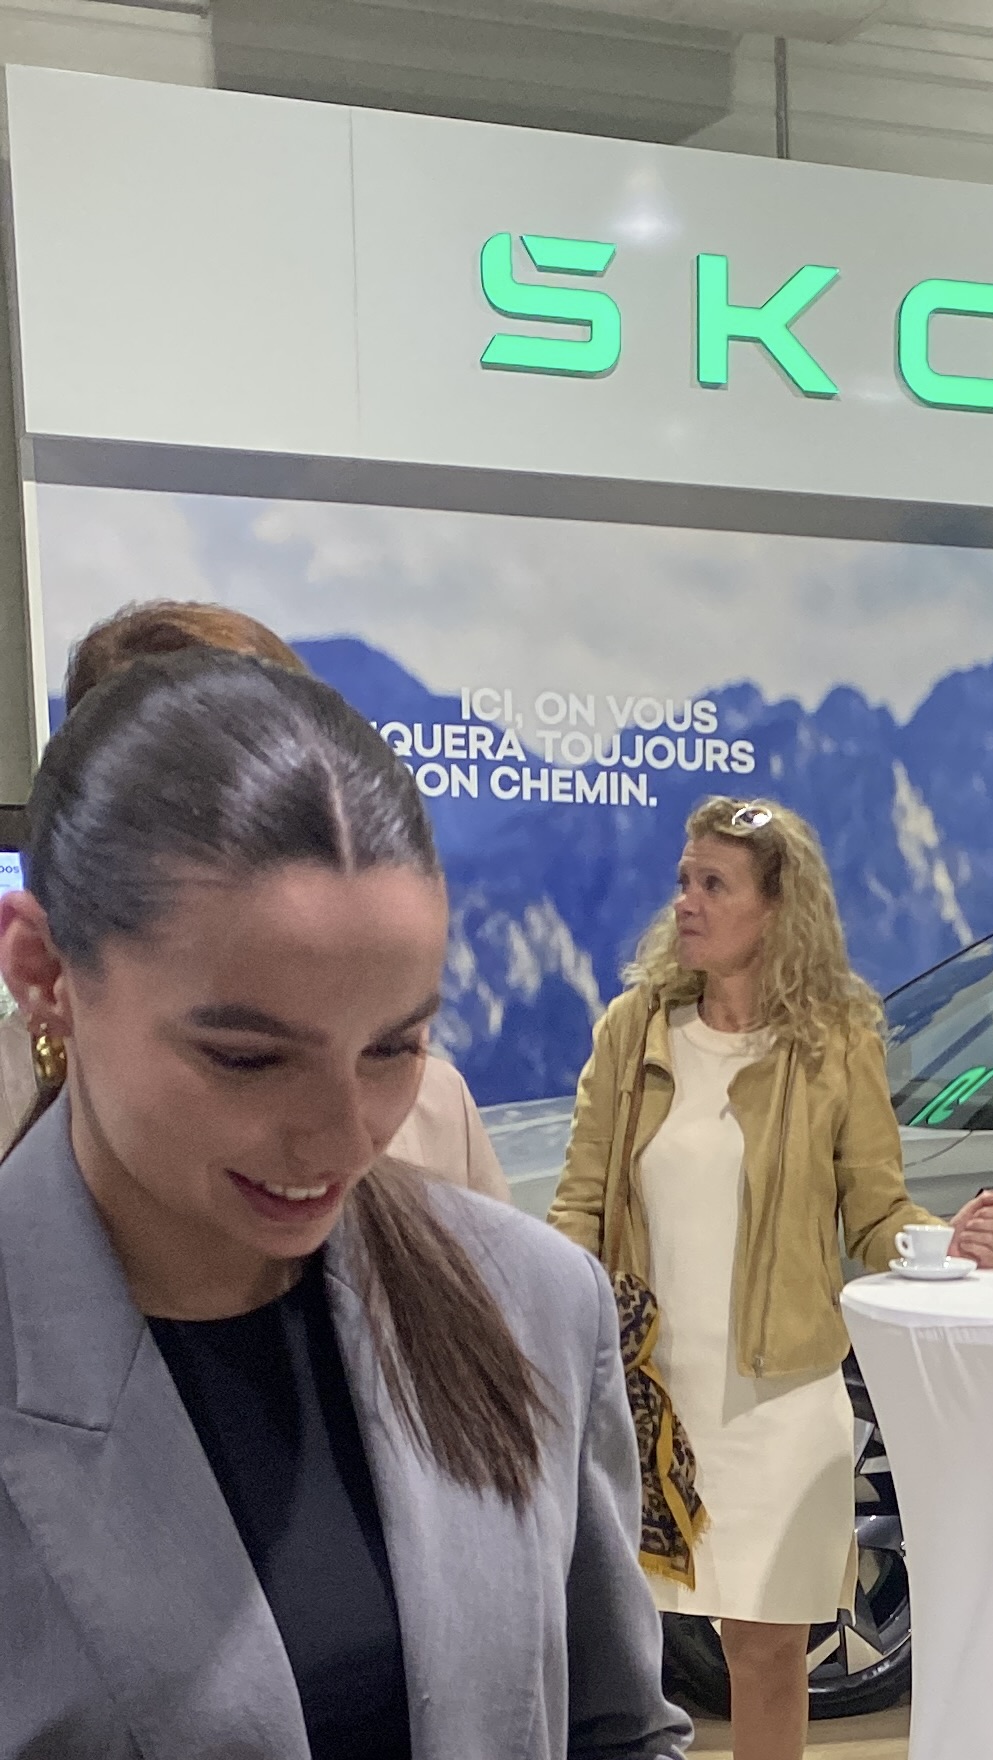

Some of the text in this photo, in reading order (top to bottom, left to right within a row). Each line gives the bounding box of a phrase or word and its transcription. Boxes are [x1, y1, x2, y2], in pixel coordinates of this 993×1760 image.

[460, 686, 719, 734] ICI, ON VOUS
[540, 729, 756, 774] TOUJOURS
[489, 765, 658, 808] CHEMIN.
